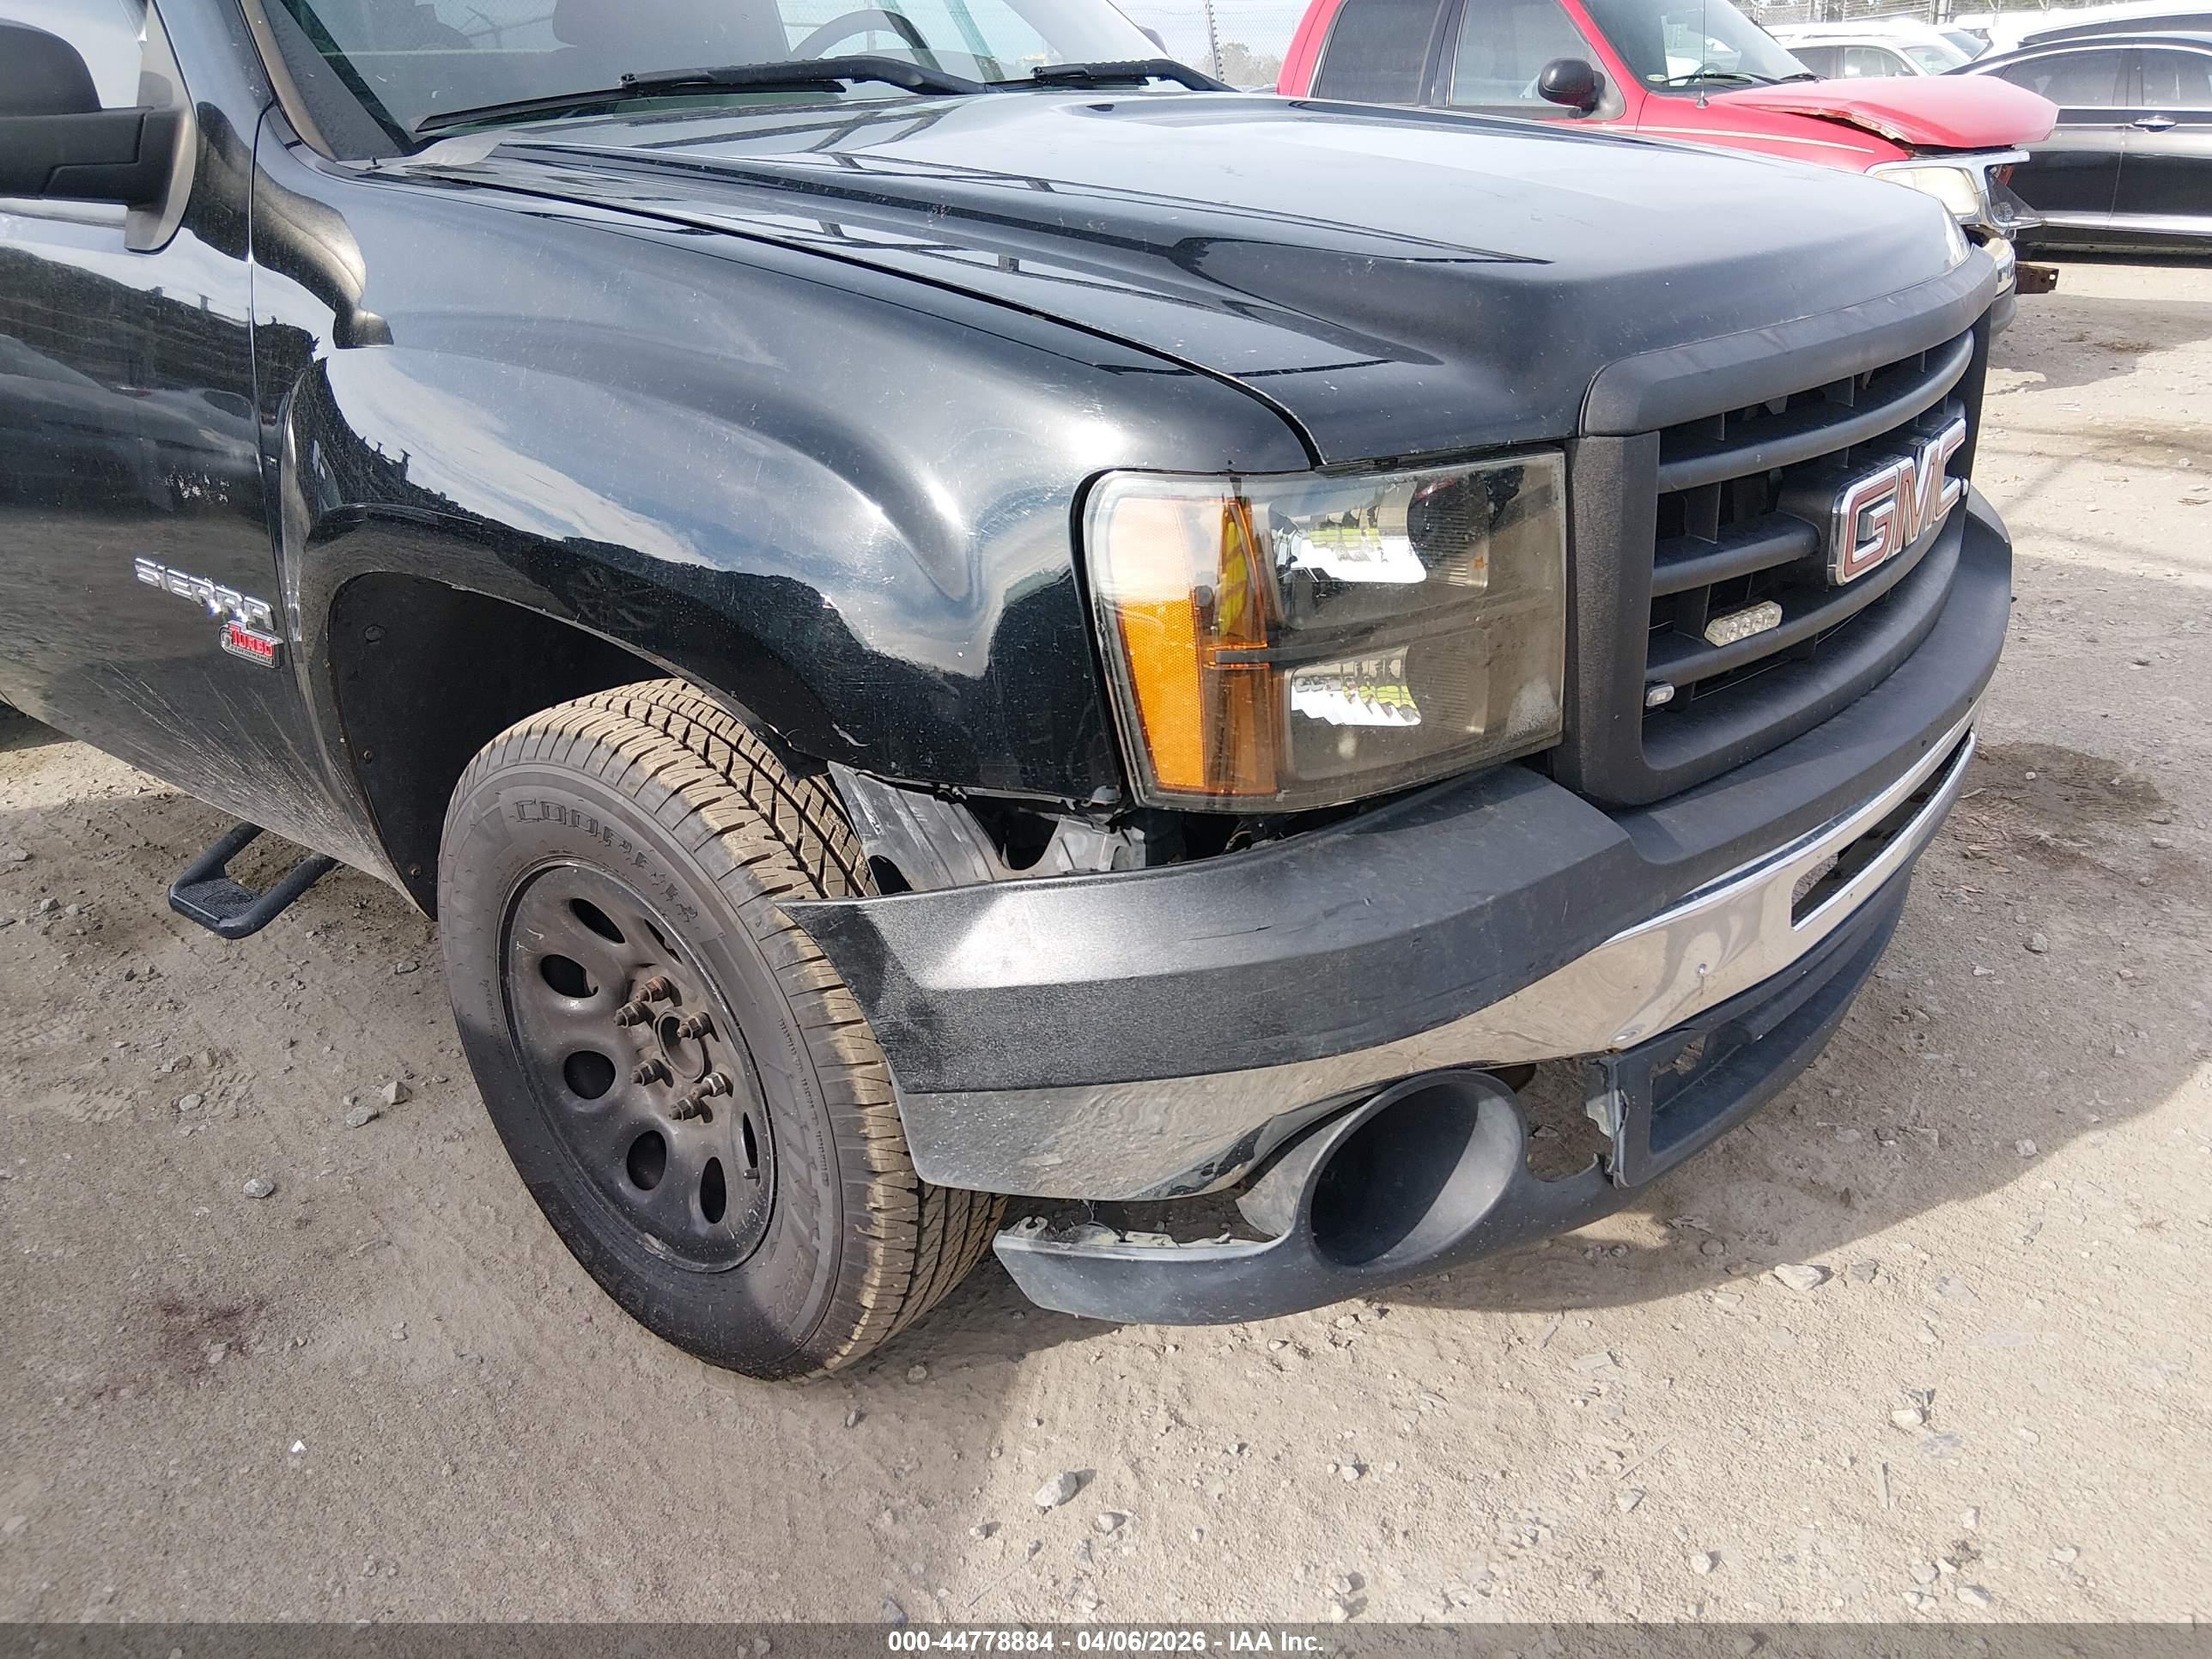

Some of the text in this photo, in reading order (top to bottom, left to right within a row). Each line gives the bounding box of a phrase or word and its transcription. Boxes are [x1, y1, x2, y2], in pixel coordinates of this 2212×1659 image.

[1831, 417, 1966, 586] GMC
[135, 557, 276, 632] SIERRA
[514, 799, 698, 924] COOPER
